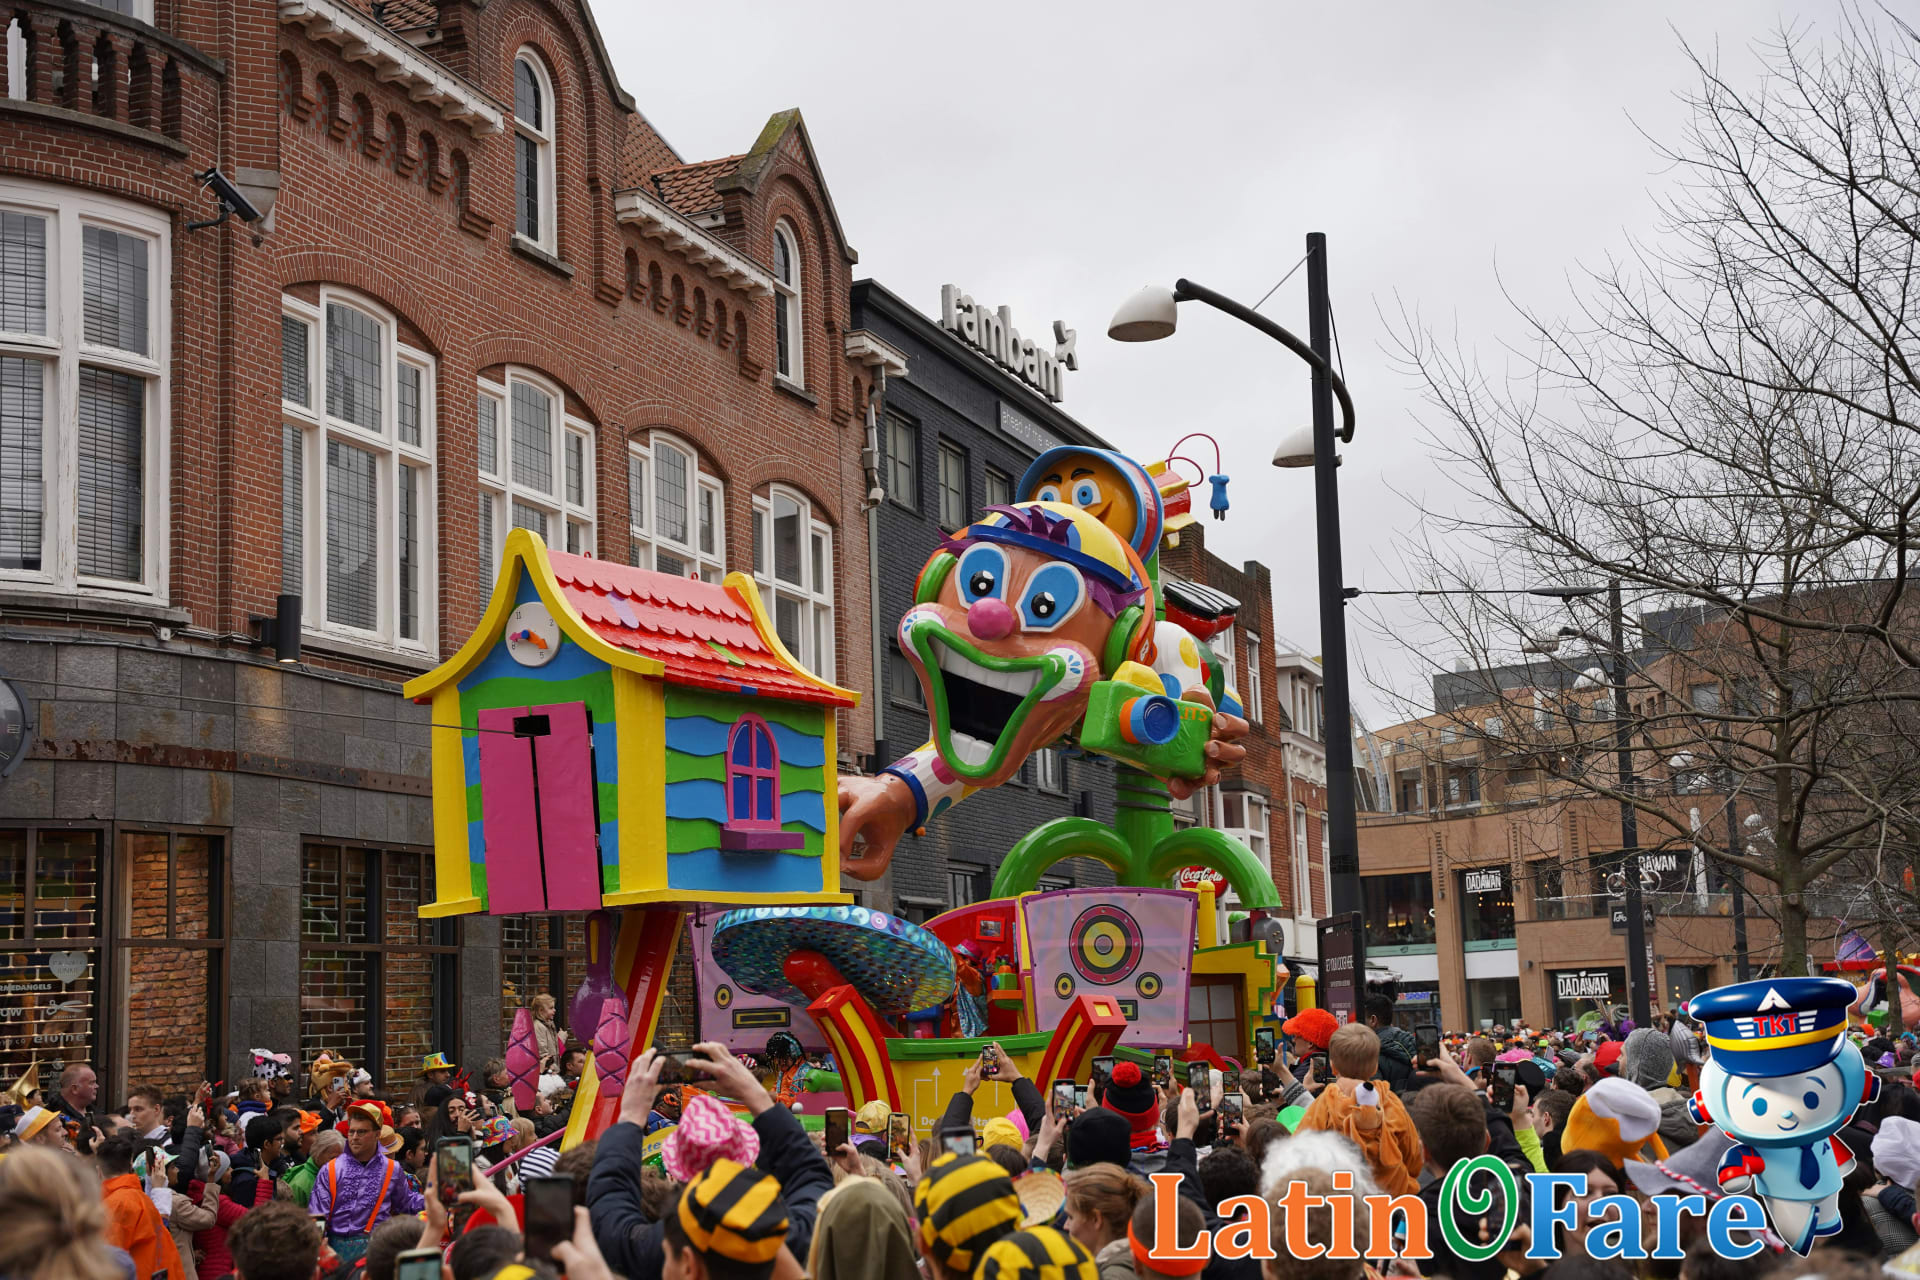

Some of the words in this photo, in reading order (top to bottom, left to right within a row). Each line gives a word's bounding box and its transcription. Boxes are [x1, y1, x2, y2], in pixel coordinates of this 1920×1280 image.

[1465, 873, 1501, 890] DADAWAN
[1645, 942, 1656, 991] HEUVEL
[1558, 976, 1609, 996] DADAWAN
